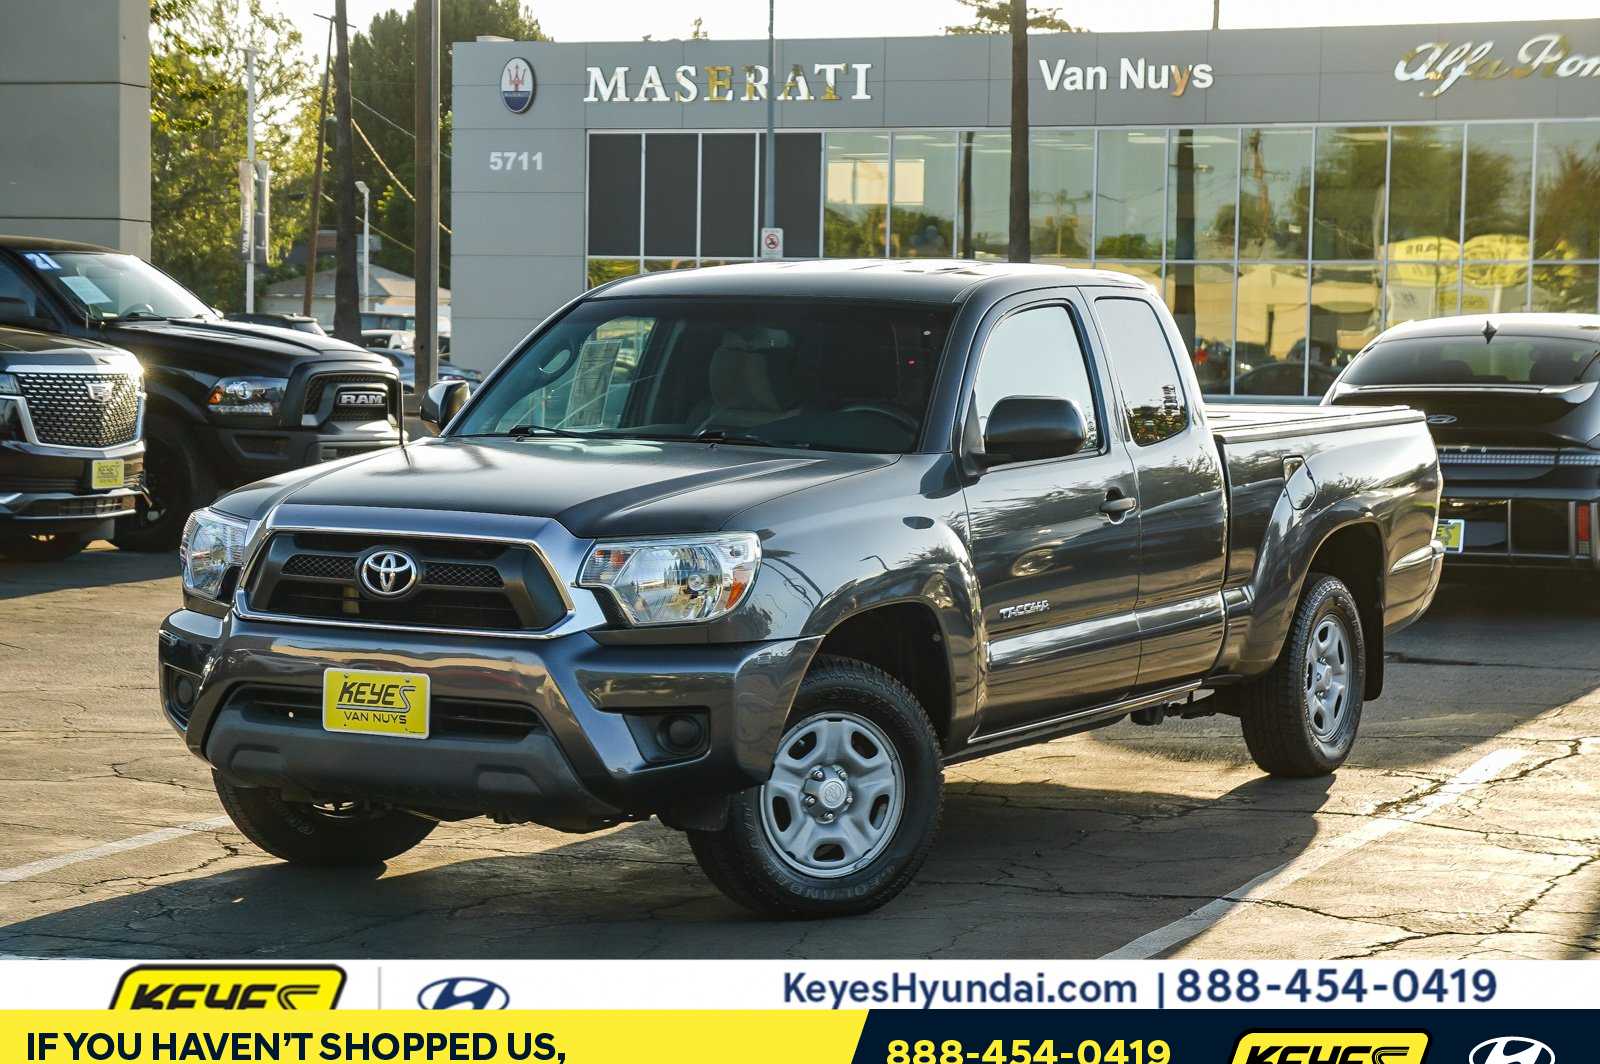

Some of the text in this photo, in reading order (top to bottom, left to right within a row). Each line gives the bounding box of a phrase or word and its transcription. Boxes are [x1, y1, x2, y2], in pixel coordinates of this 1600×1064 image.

[583, 62, 872, 102] MASERATI
[1039, 57, 1214, 97] Van Nuys
[1394, 40, 1510, 99] Alfa
[489, 151, 543, 171] 5711
[340, 394, 384, 404] RAM
[336, 681, 416, 713] KEYES
[344, 711, 407, 725] VAN NUYS
